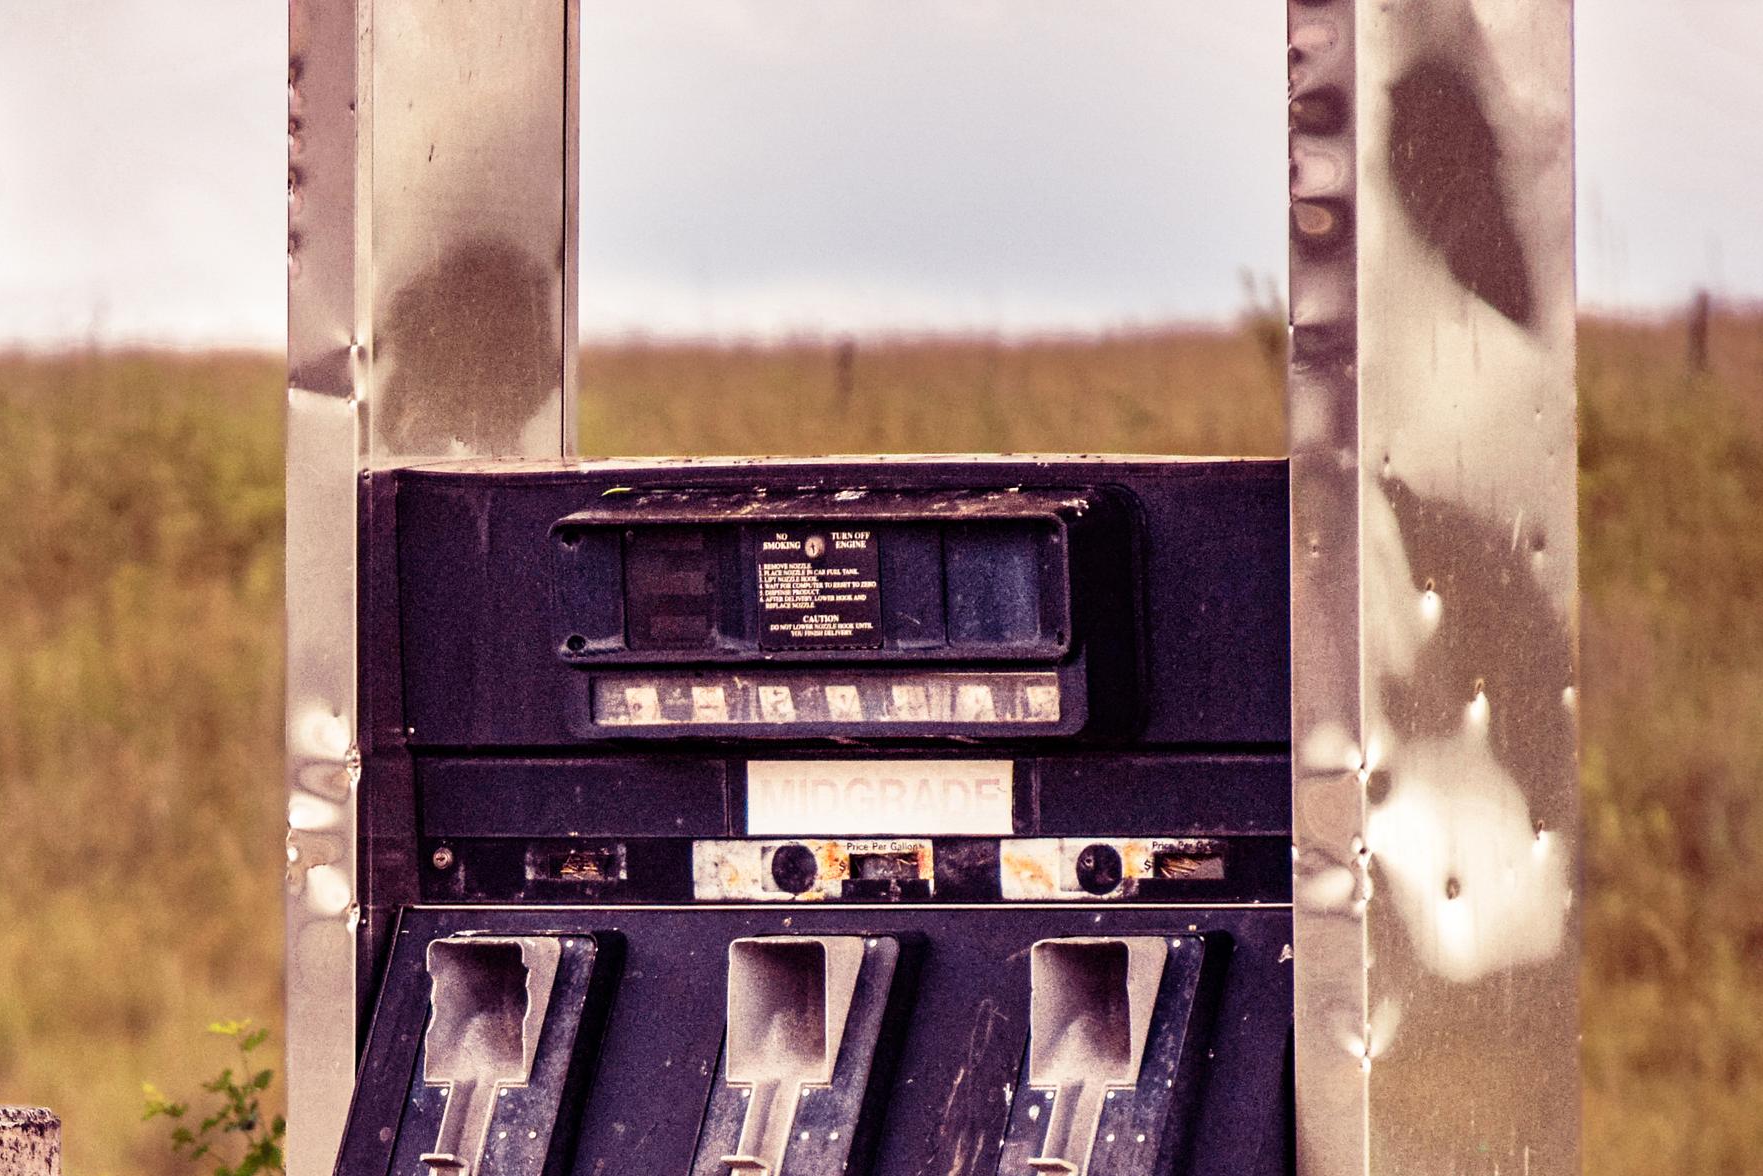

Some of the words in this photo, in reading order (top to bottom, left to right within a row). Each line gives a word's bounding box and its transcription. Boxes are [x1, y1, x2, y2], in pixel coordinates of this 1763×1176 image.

[776, 533, 788, 541] NO
[831, 531, 853, 540] TURN
[854, 531, 871, 540] OFF
[763, 541, 801, 550] SMOKING
[835, 540, 867, 549] ENGINE
[802, 614, 840, 623] CAUTION
[759, 777, 1000, 821] MIDGRADE
[846, 842, 869, 851] Price
[872, 842, 887, 851] Per
[890, 842, 919, 852] Gallon
[838, 860, 847, 873] $
[1143, 859, 1152, 871] $
